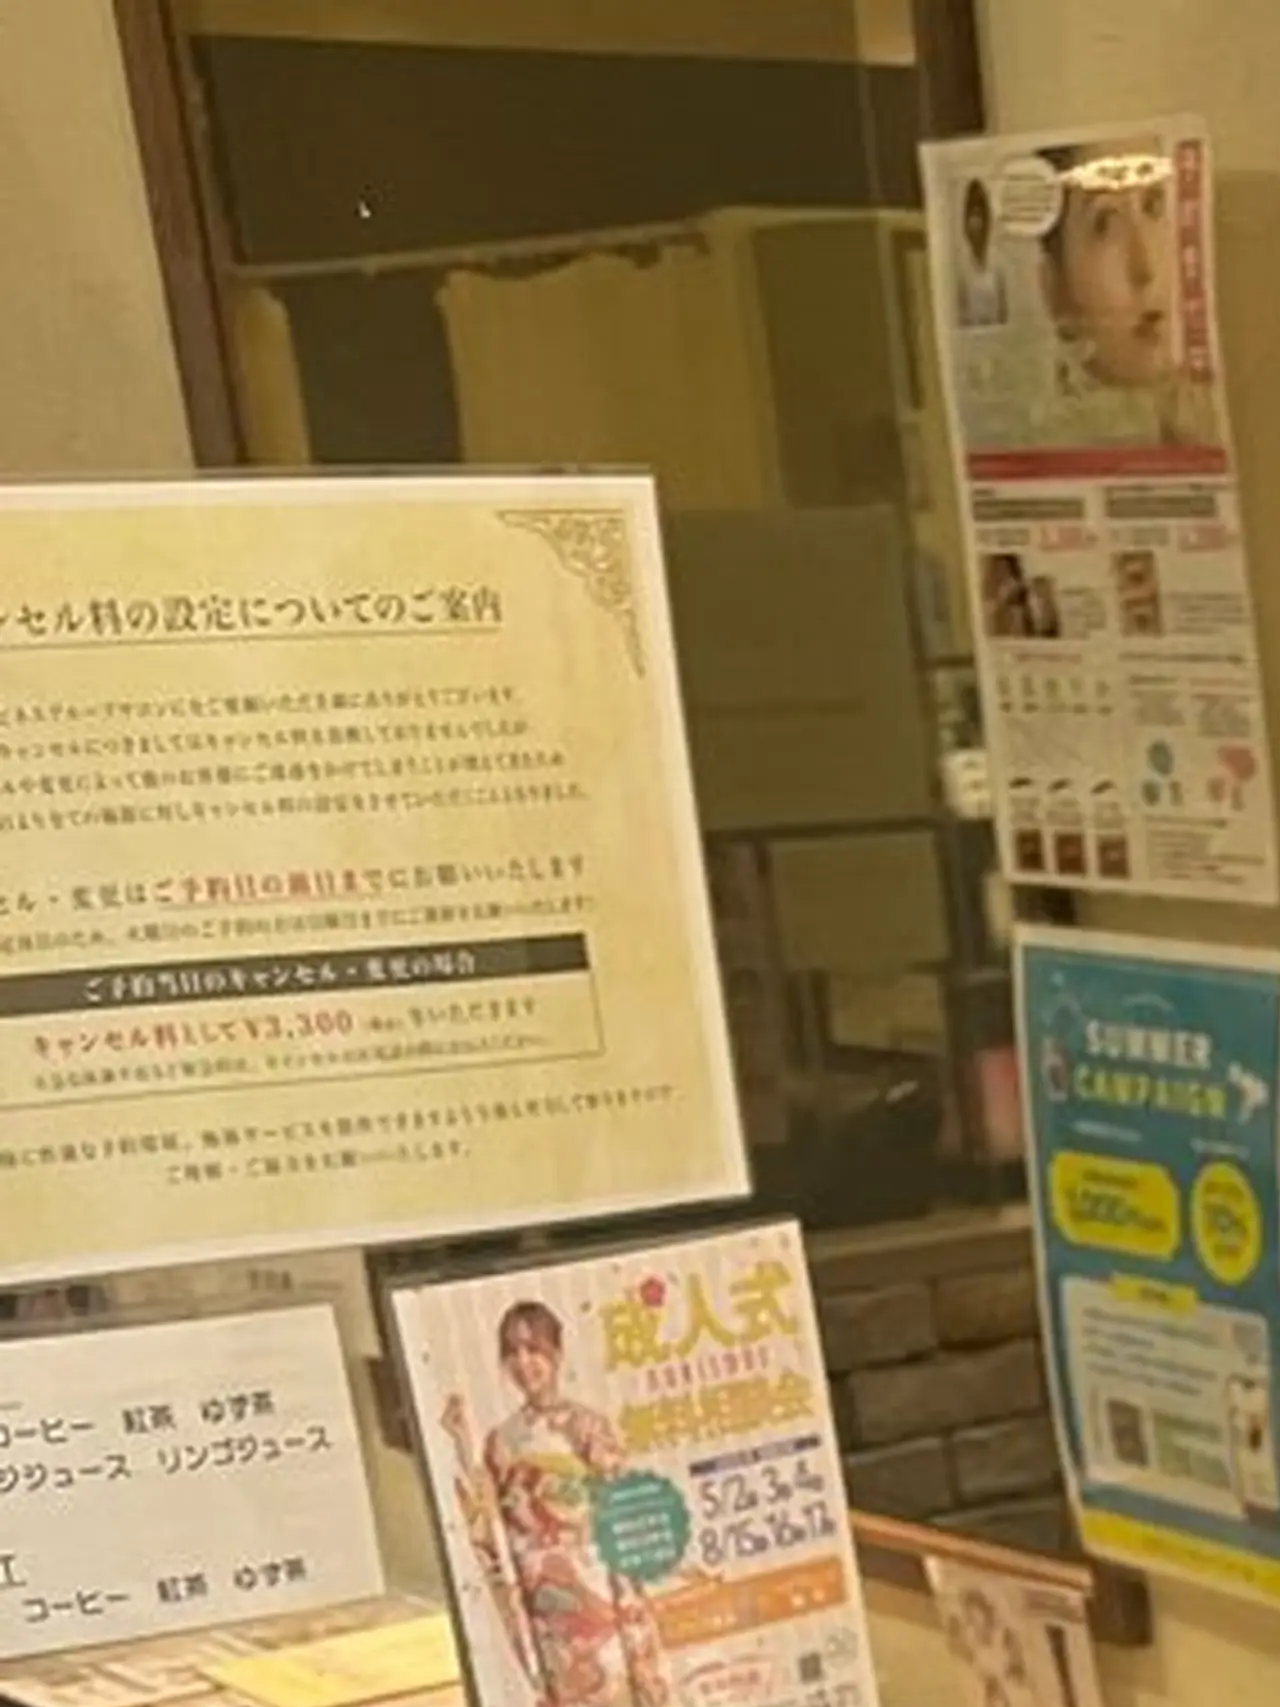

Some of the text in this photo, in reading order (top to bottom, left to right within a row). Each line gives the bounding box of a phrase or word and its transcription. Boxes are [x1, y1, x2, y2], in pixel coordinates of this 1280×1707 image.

[0, 586, 503, 637] セル料の設定についてのご案内
[122, 1403, 177, 1434] 紅茶
[201, 1390, 276, 1425] ゆず茶
[158, 1425, 334, 1474] リンゴジュース
[22, 1558, 308, 1623] コーヒー 紅茶 ゆず茶
